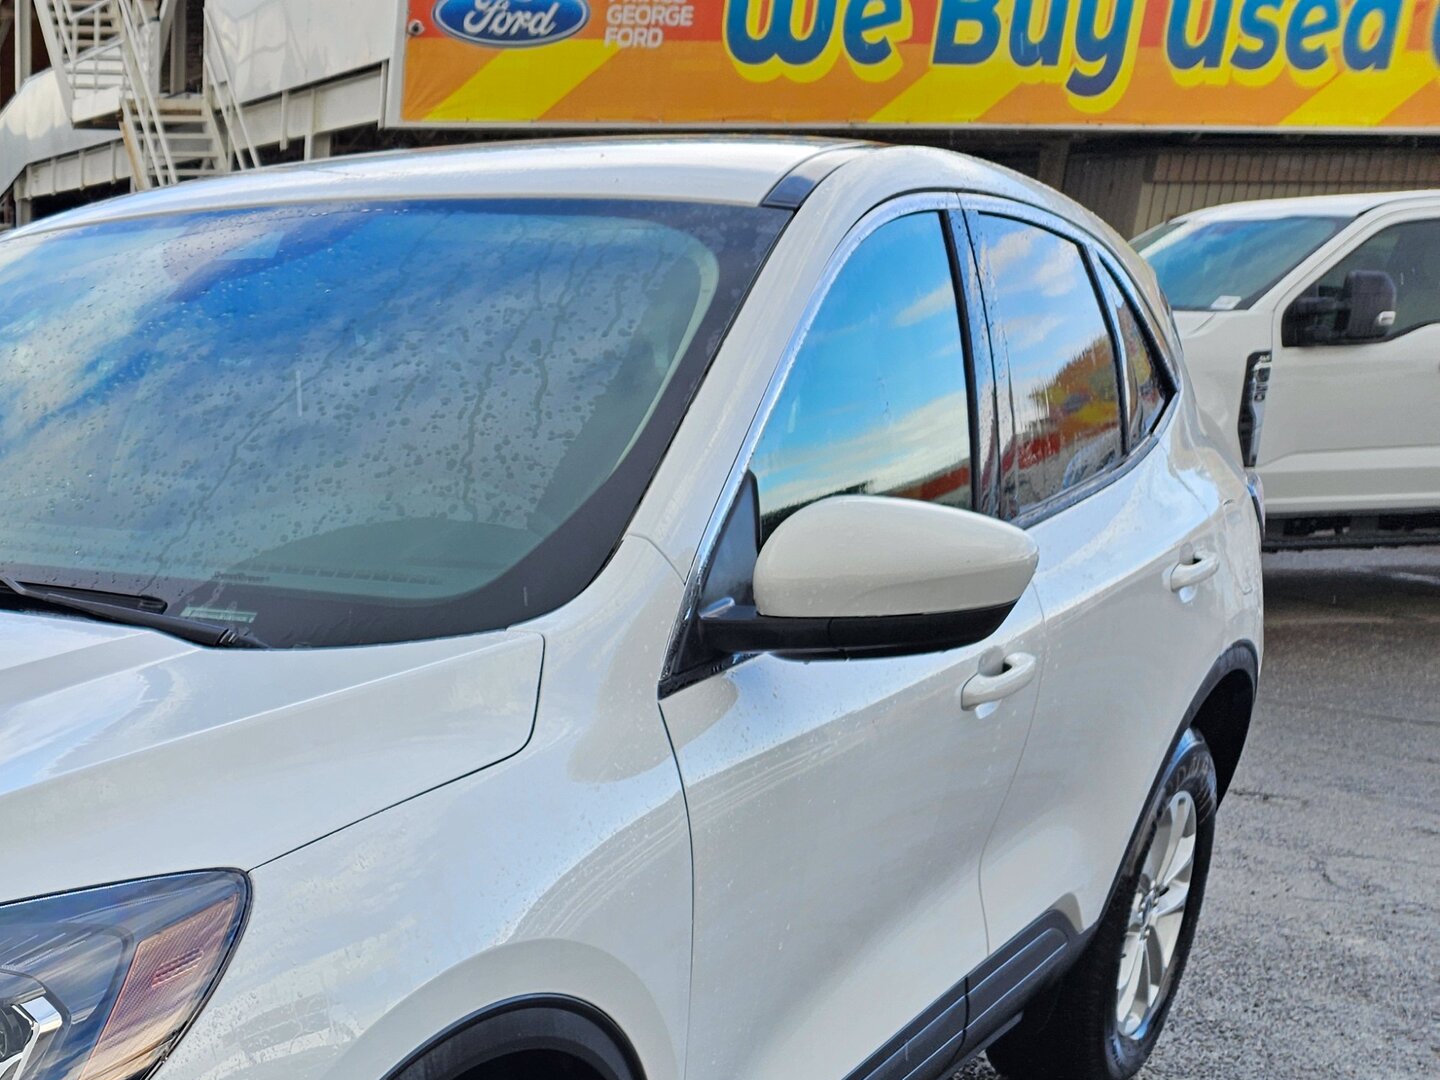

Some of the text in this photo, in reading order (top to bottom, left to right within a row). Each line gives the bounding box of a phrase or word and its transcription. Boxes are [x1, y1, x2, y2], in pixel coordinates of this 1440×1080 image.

[463, 0, 558, 36] Ford
[607, 4, 695, 27] GEORGE
[604, 27, 664, 49] FORD
[723, 0, 904, 67] We
[931, 0, 1137, 97] Buy
